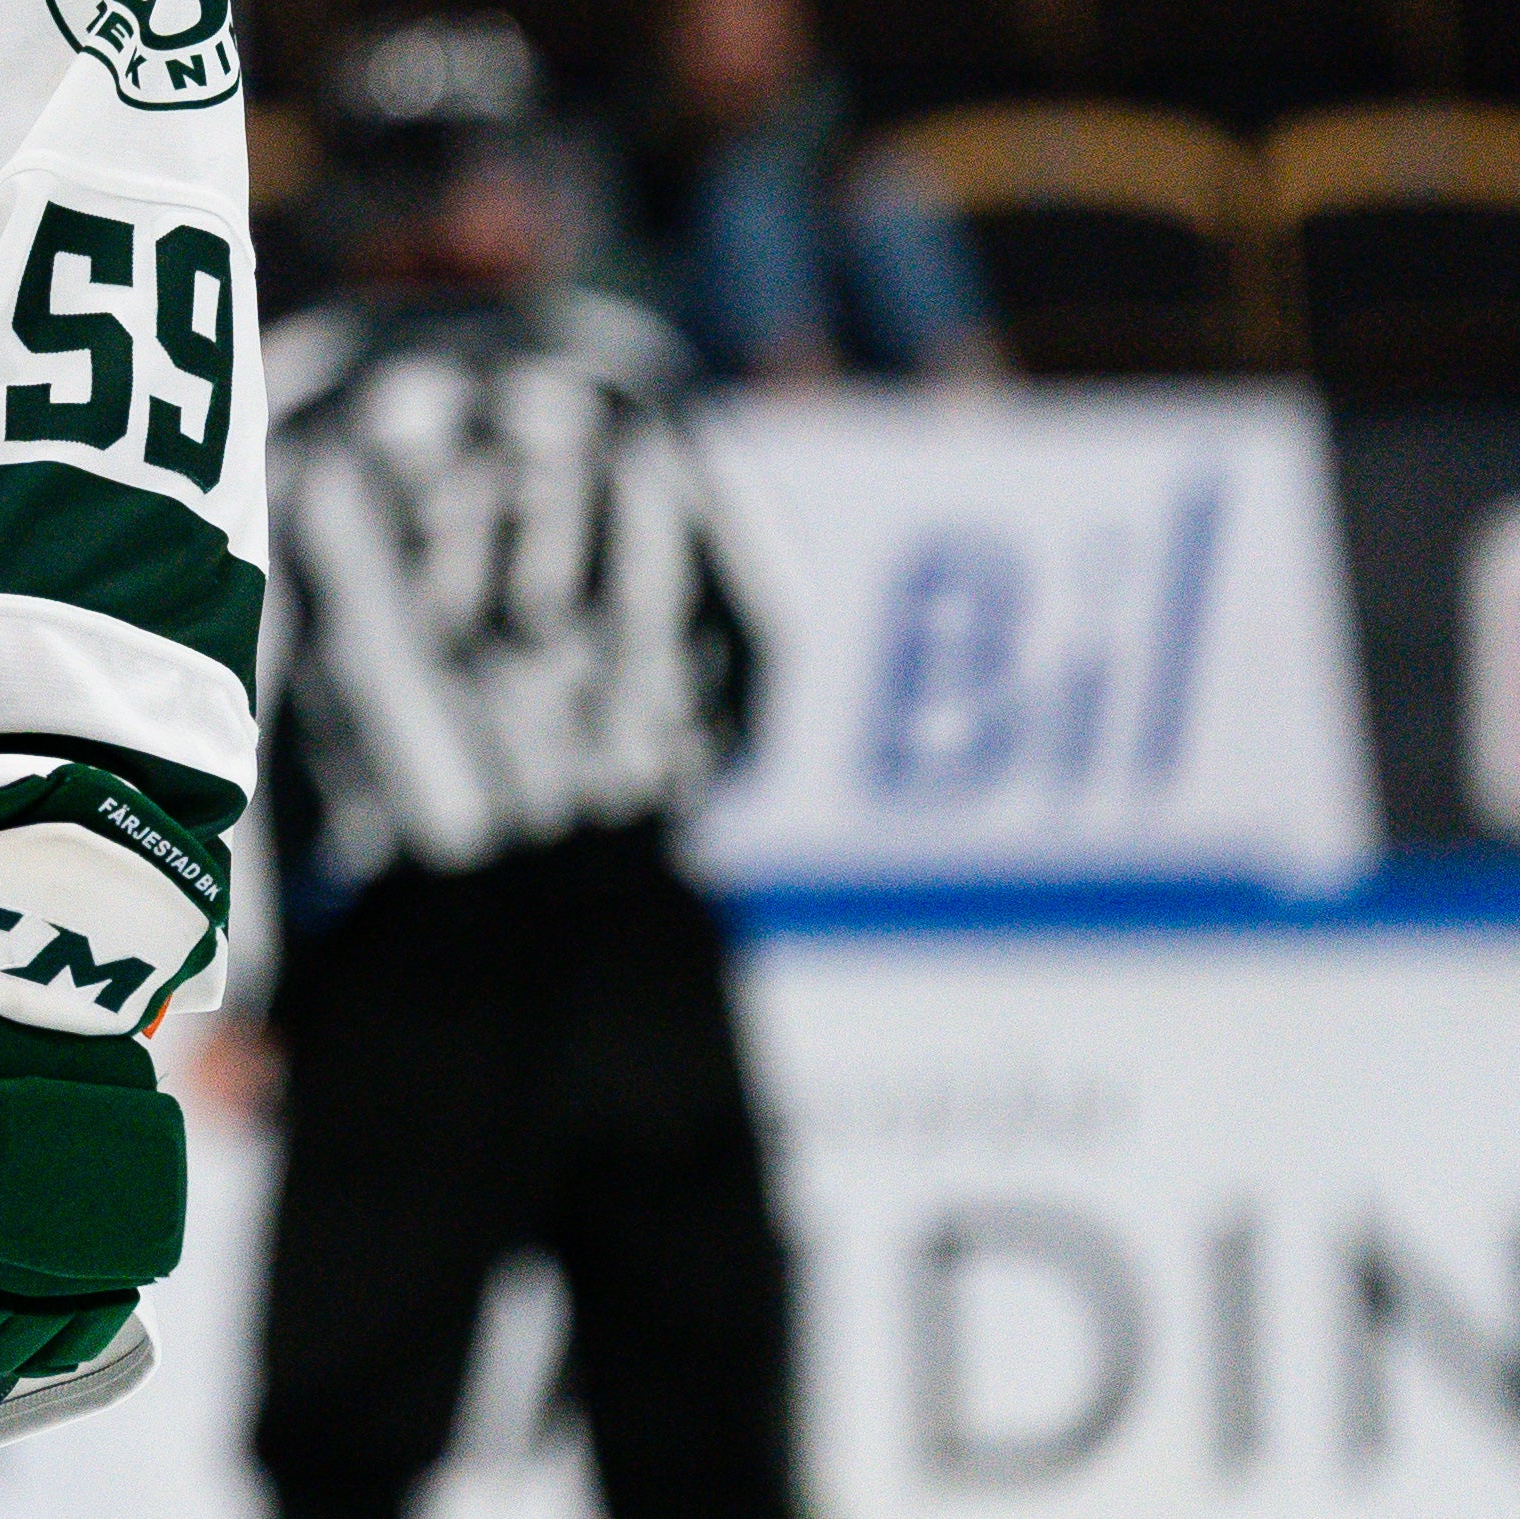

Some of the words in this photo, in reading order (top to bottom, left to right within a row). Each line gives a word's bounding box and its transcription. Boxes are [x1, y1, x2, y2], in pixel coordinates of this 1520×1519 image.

[3, 199, 235, 495] 59
[97, 796, 202, 880] FÄRJESTAD
[194, 872, 222, 903] BK
